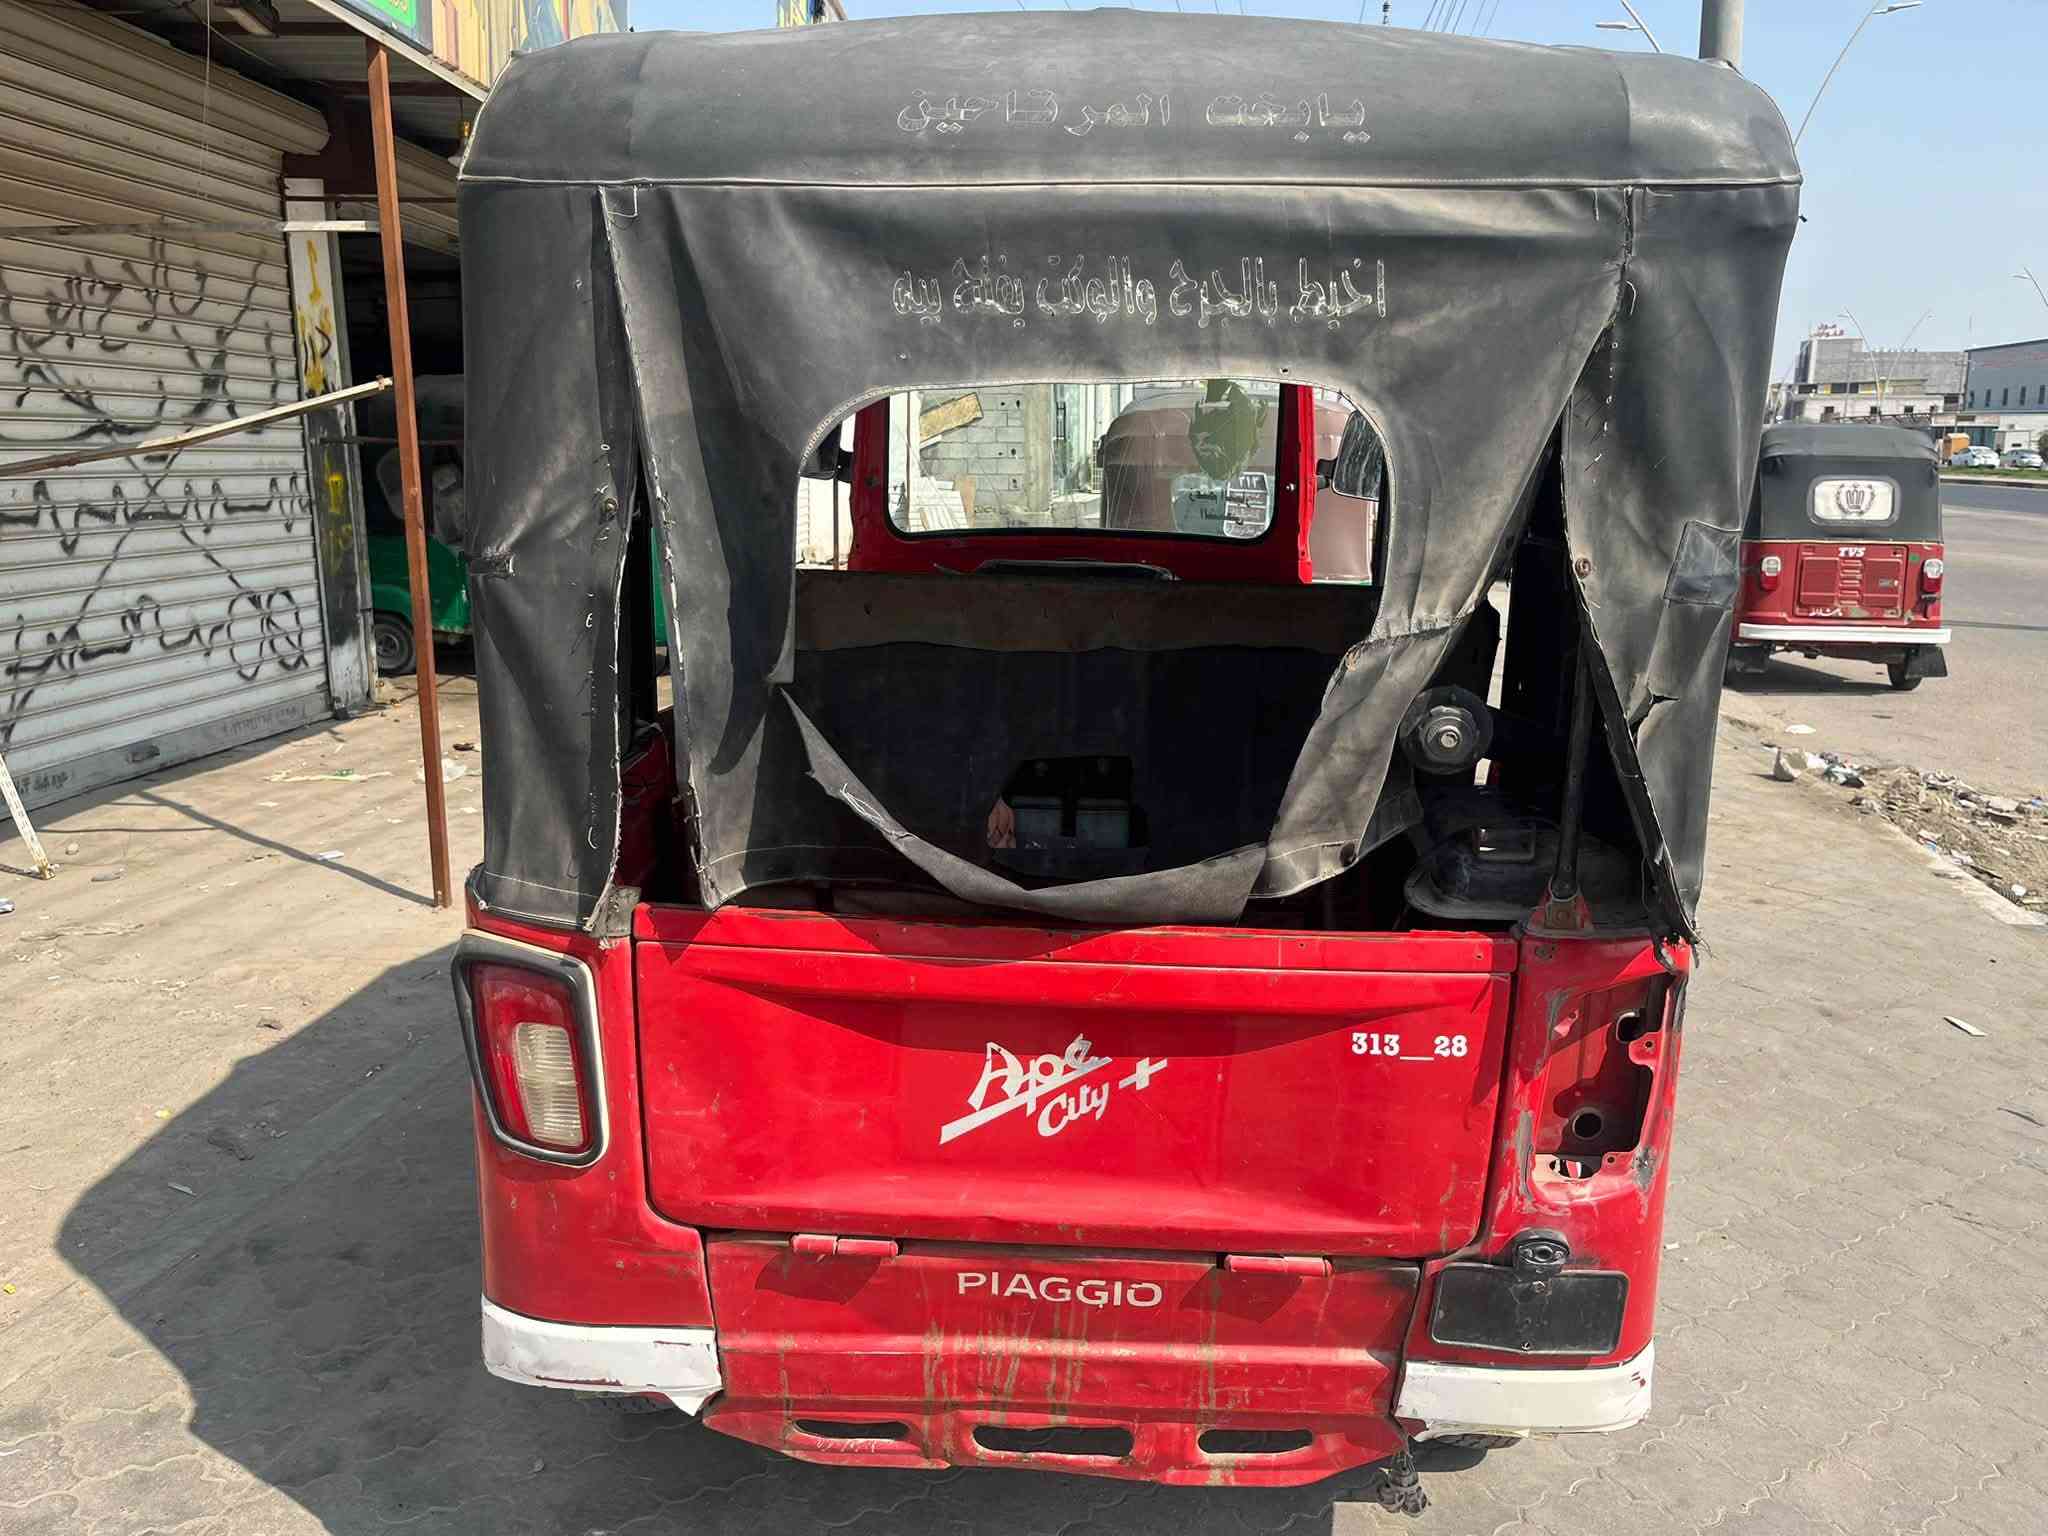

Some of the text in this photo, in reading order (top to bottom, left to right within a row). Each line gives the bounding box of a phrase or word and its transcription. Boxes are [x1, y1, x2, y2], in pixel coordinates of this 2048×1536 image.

[1838, 546, 1866, 558] TVS
[960, 1033, 1112, 1121] Ape
[1037, 1082, 1110, 1137] City
[956, 1271, 1164, 1309] PIAGGIO
